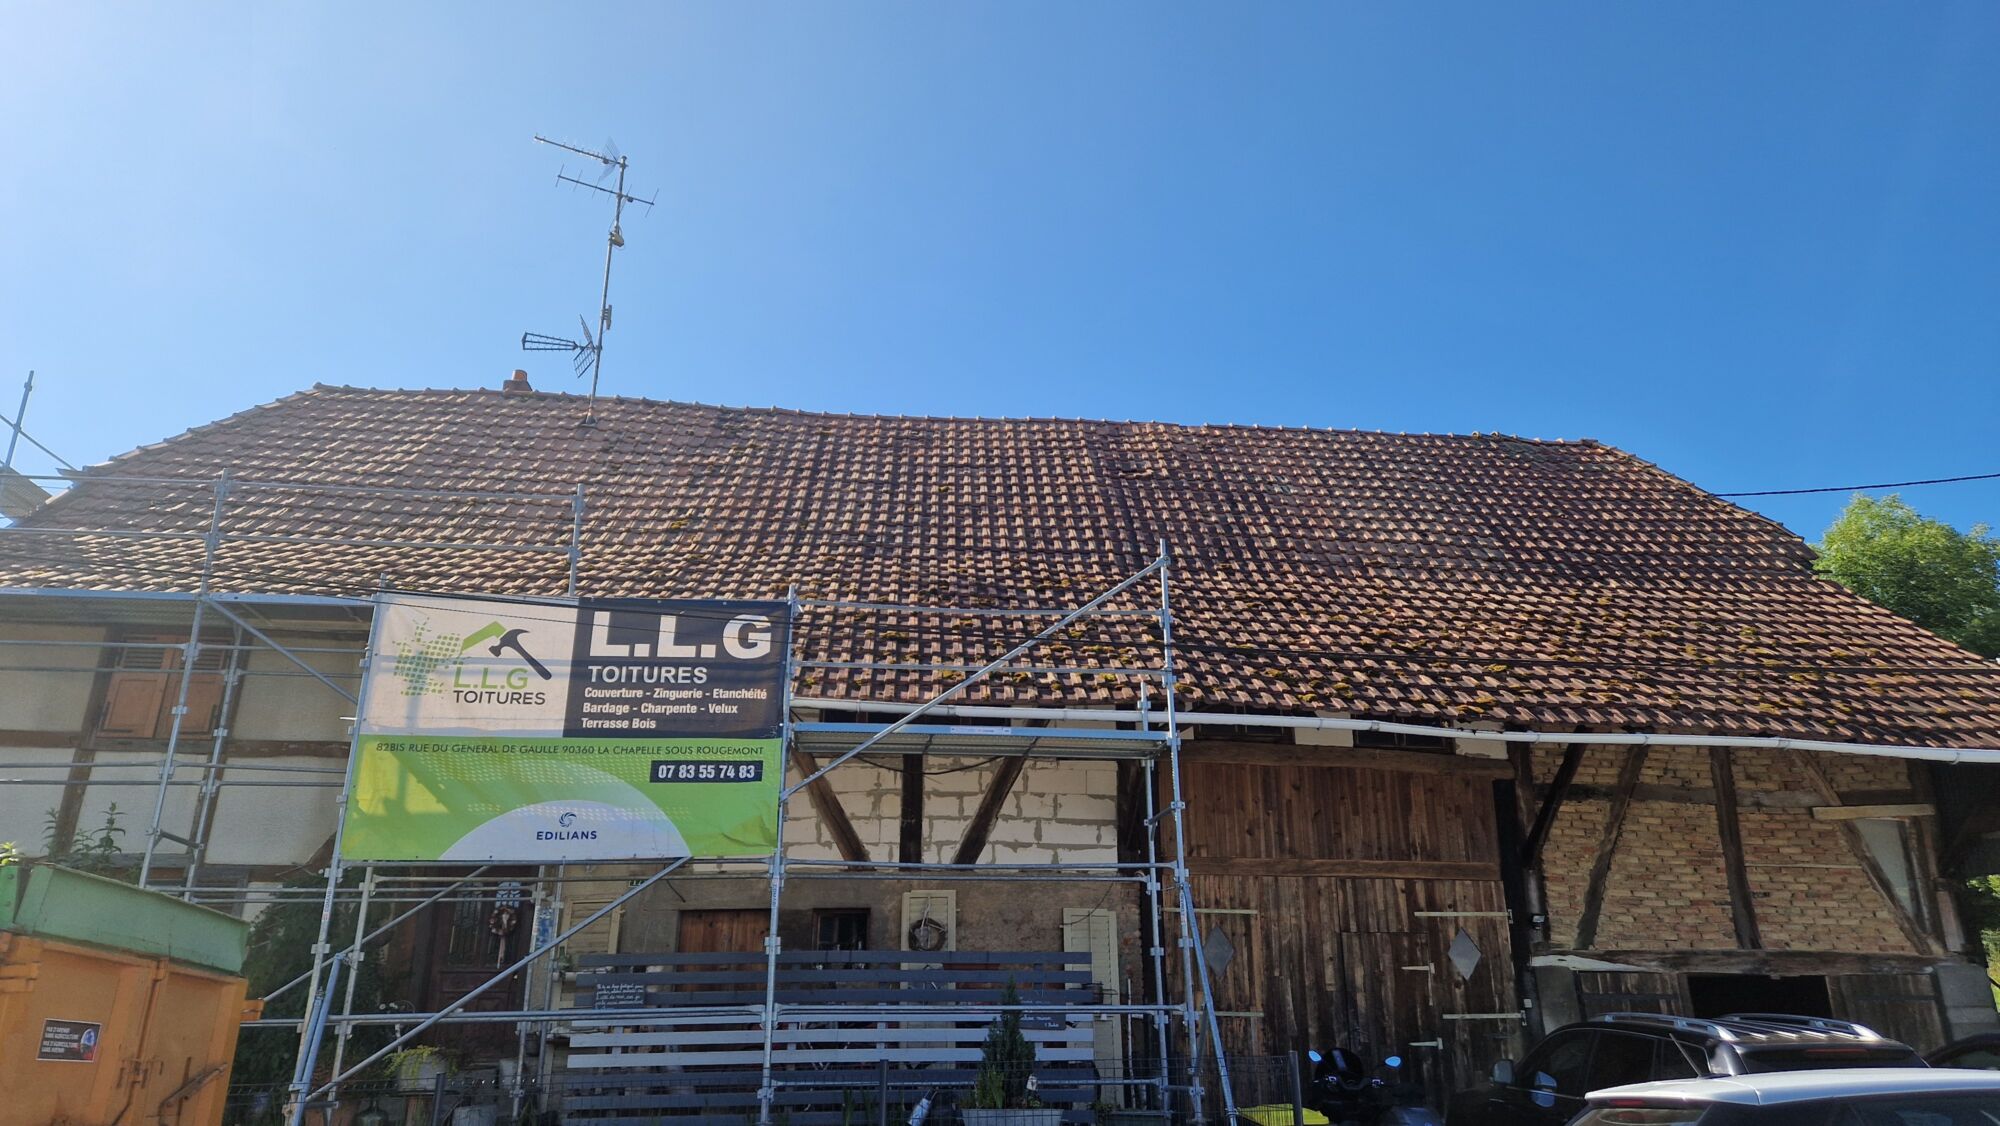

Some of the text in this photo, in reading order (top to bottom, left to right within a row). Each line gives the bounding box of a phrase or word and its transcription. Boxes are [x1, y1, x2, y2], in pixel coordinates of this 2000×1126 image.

[589, 611, 772, 660] L.L.G
[453, 667, 529, 690] L.L.G
[587, 665, 708, 684] TOITURES
[453, 690, 546, 705] TOITURES
[584, 687, 644, 699] Couverture
[653, 688, 703, 700] Zinguerie
[713, 688, 767, 700] Etanchéité
[583, 703, 630, 715] Bardage
[641, 703, 697, 715] Charpente
[708, 704, 738, 714] Velux
[581, 718, 656, 729] Terrasse Bois
[376, 743, 764, 755] 82BIS RUE DU GENERAL DE GAULLE 90360 LA CHAPELLE SOUS ROUGEMONT
[658, 765, 755, 779] 07 83 55 74 83
[536, 831, 597, 840] EDILIANS
